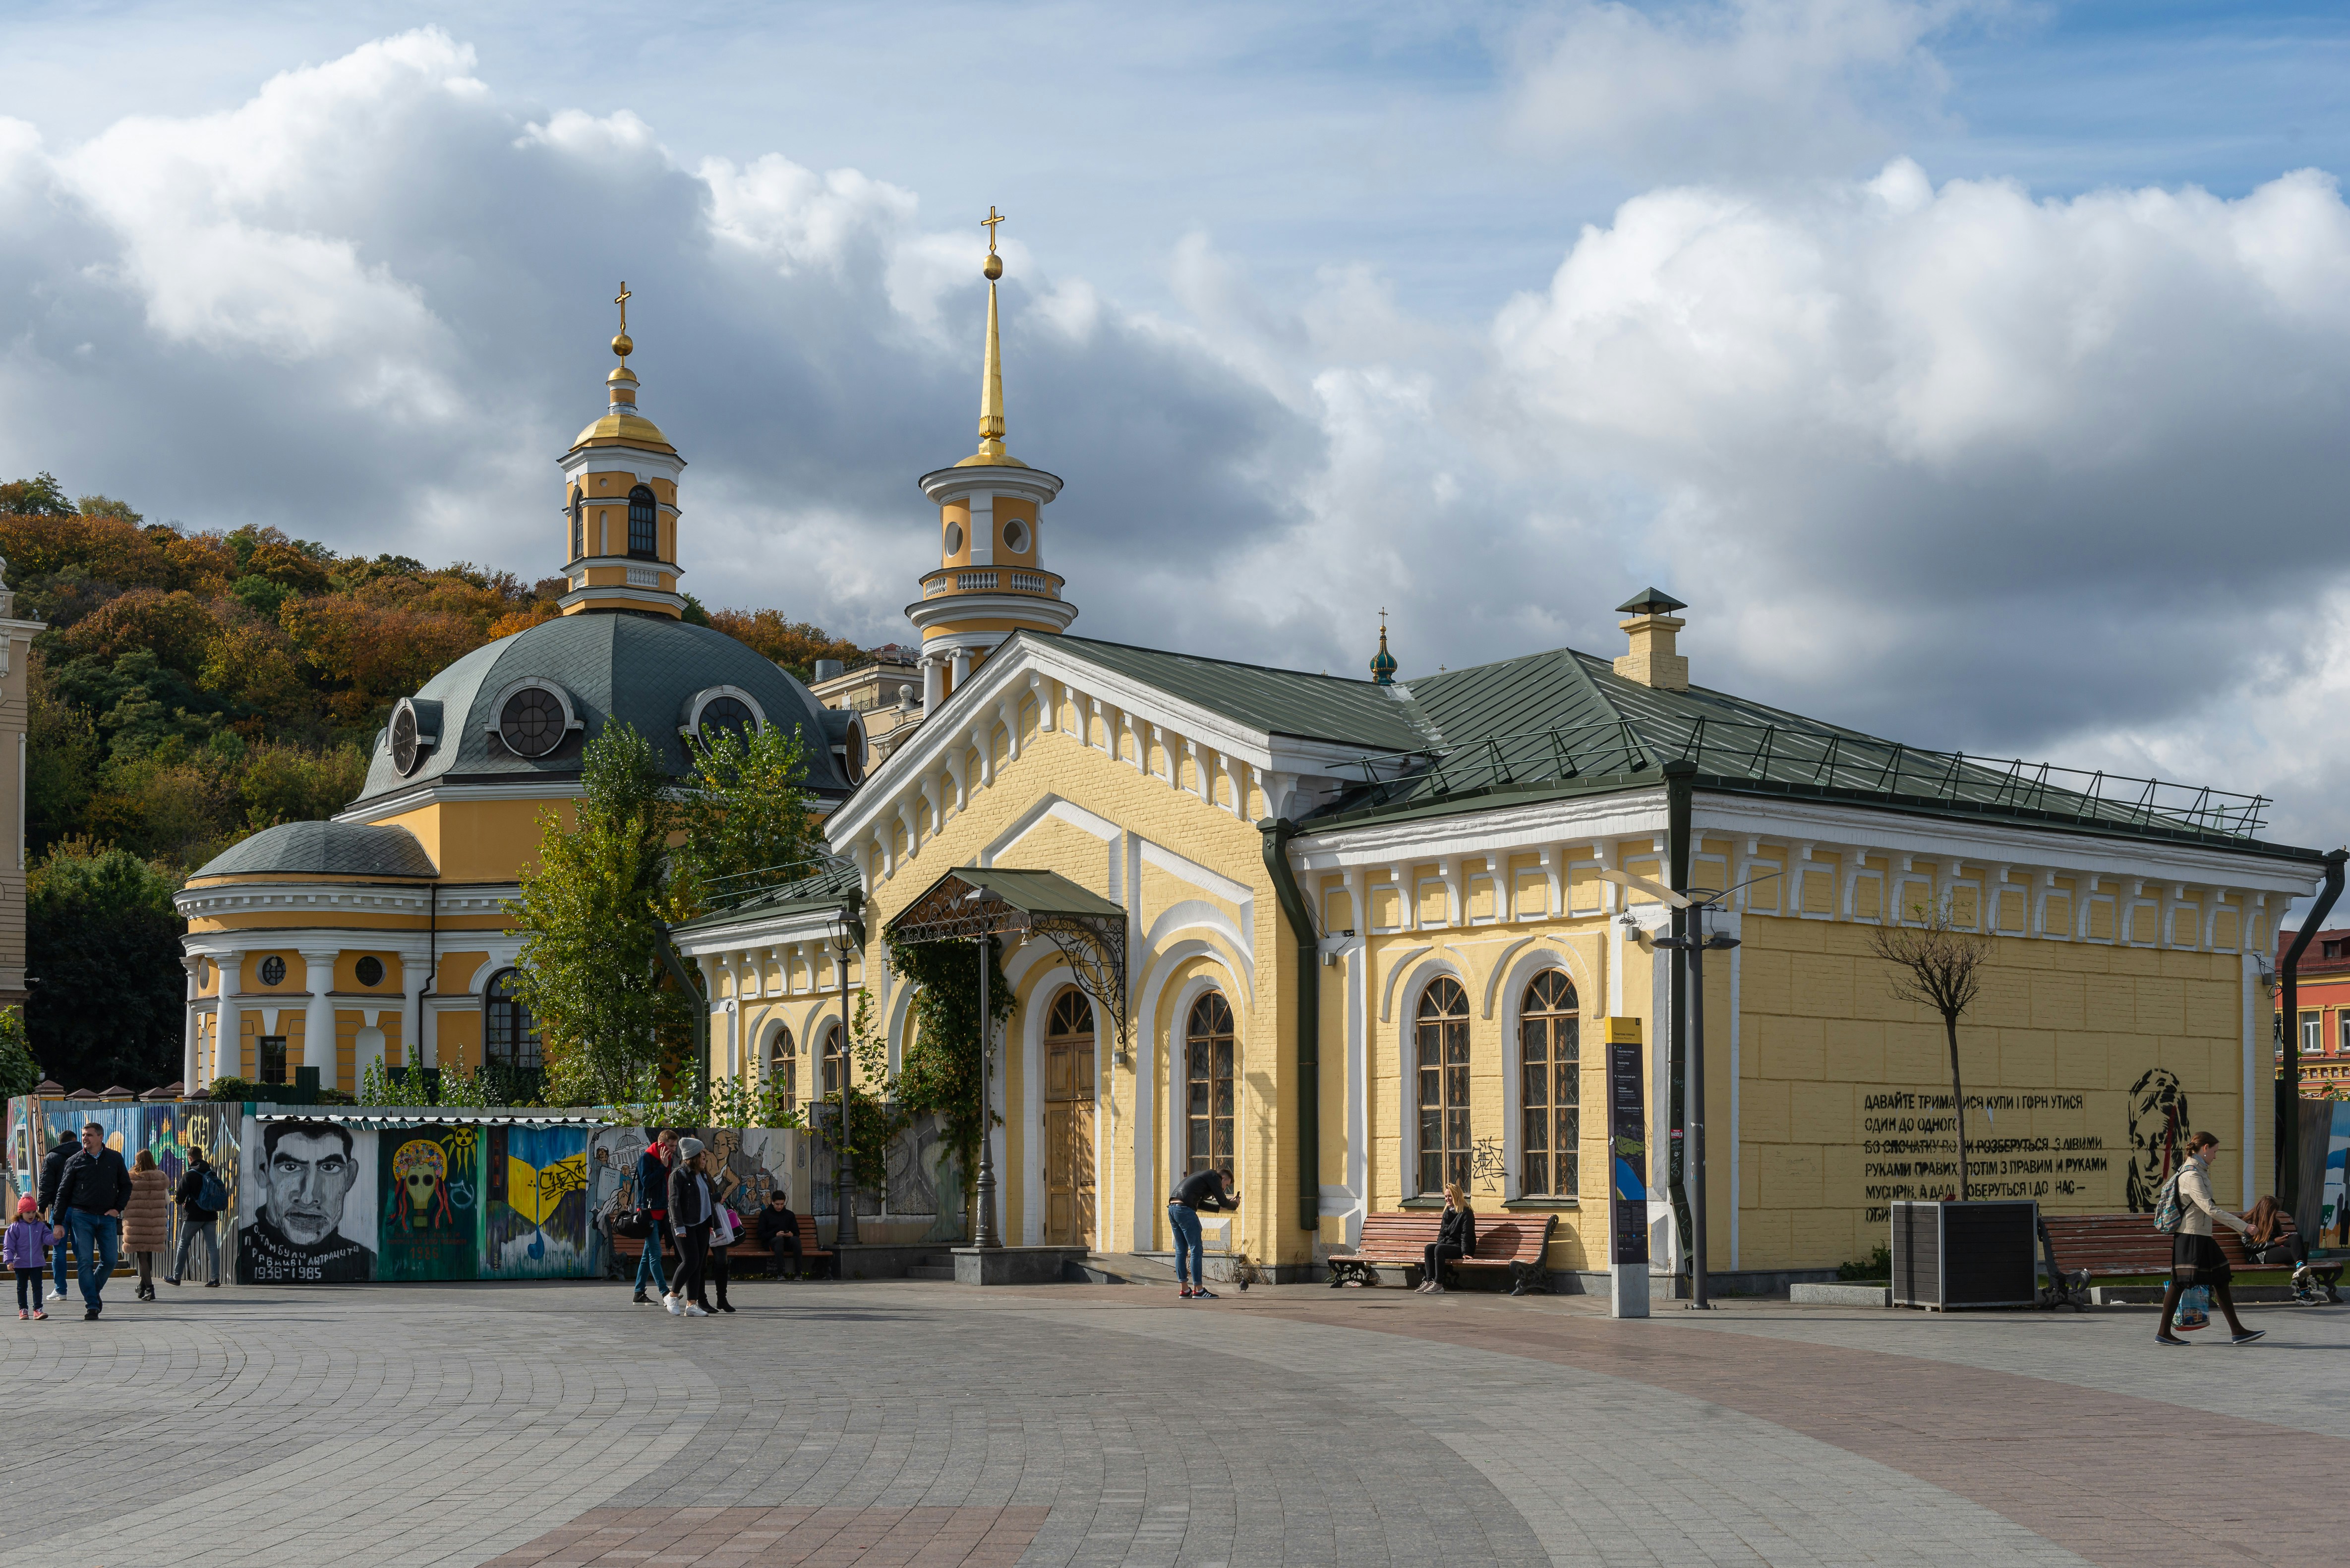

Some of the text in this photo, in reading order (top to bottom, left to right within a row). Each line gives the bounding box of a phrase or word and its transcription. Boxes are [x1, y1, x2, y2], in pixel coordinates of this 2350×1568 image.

[1865, 1091, 1915, 1111] ДАВАЙТЕ
[1918, 1095, 1983, 1109] ТРИМАИСЯ
[1987, 1096, 2013, 1109] КУПИ
[1865, 1117, 1896, 1134] ОДИН
[1899, 1117, 1914, 1134] ДО
[1865, 1140, 1880, 1154] БО
[1882, 1139, 1939, 1154] СПОЧАТКУ
[1942, 1139, 1974, 1154] ВОИ
[1976, 1138, 2049, 1154] РОЗБЕРУТЬСЯ
[2063, 1136, 2103, 1151] ЛІВИМИ
[1865, 1161, 1911, 1177] РУКАМИ
[1967, 1161, 1998, 1175] ПОТІМ
[2000, 1161, 2007, 1174] З
[2066, 1158, 2108, 1173] РУКАМИ
[1920, 1184, 1928, 1199] А
[1967, 1182, 2026, 1197] ОБЕРУТЬСЯ
[2034, 1181, 2049, 1197] ДО
[307, 1245, 359, 1266] АНТРАЦИТИ
[410, 1246, 439, 1260] 1986
